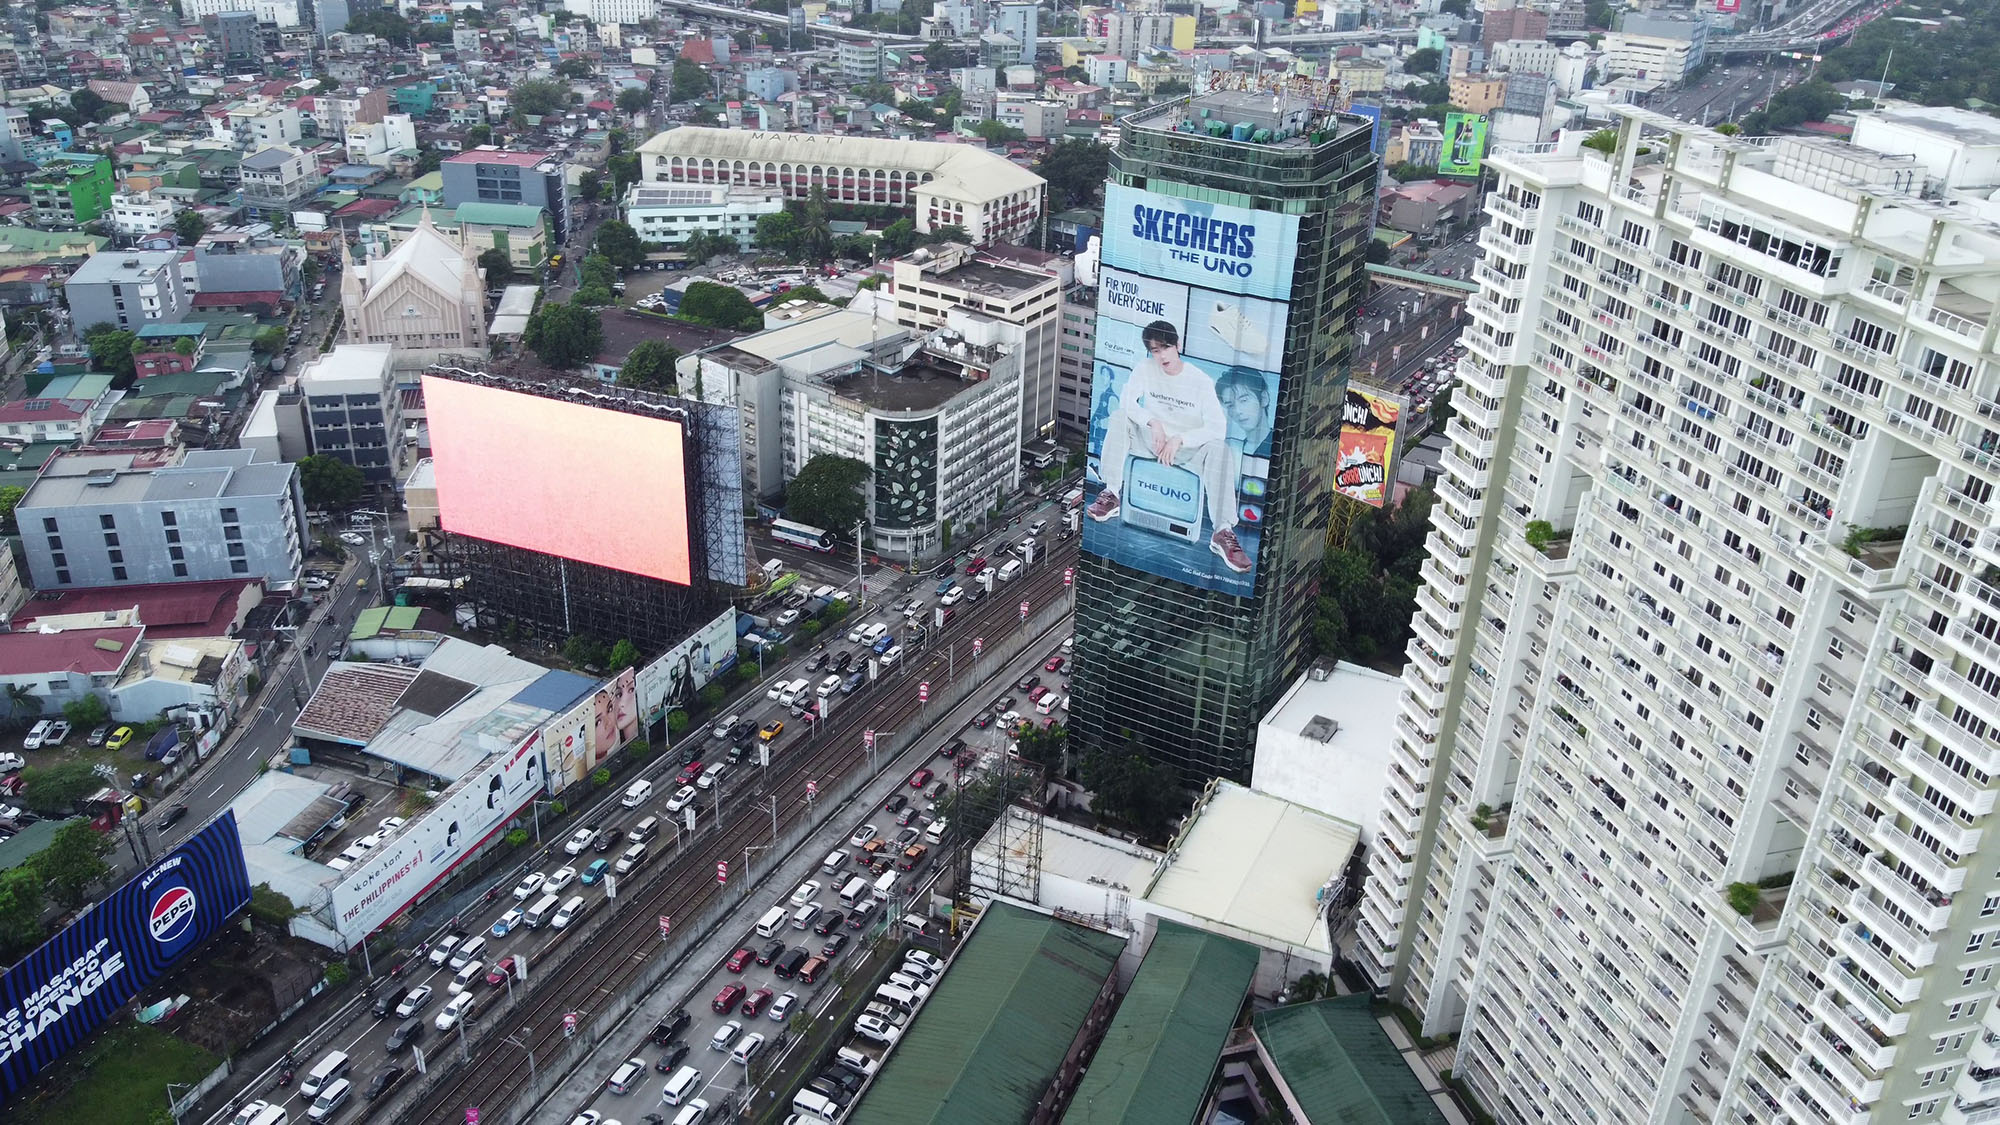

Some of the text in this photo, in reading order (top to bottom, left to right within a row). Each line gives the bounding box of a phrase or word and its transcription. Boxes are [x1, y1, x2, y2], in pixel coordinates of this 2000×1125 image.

[751, 132, 844, 144] MAKATI
[1132, 204, 1256, 259] SKECHERS
[1169, 249, 1253, 278] THE UNO
[1137, 479, 1191, 502] THE UNO
[141, 856, 182, 890] ALL-NEW
[342, 904, 360, 922] THE
[412, 849, 423, 868] #1
[152, 897, 194, 933] PEPSI
[23, 937, 108, 1009] MASARAP
[25, 979, 73, 1020] OPEN
[75, 958, 99, 980] TO
[0, 951, 125, 1065] CHANGE
